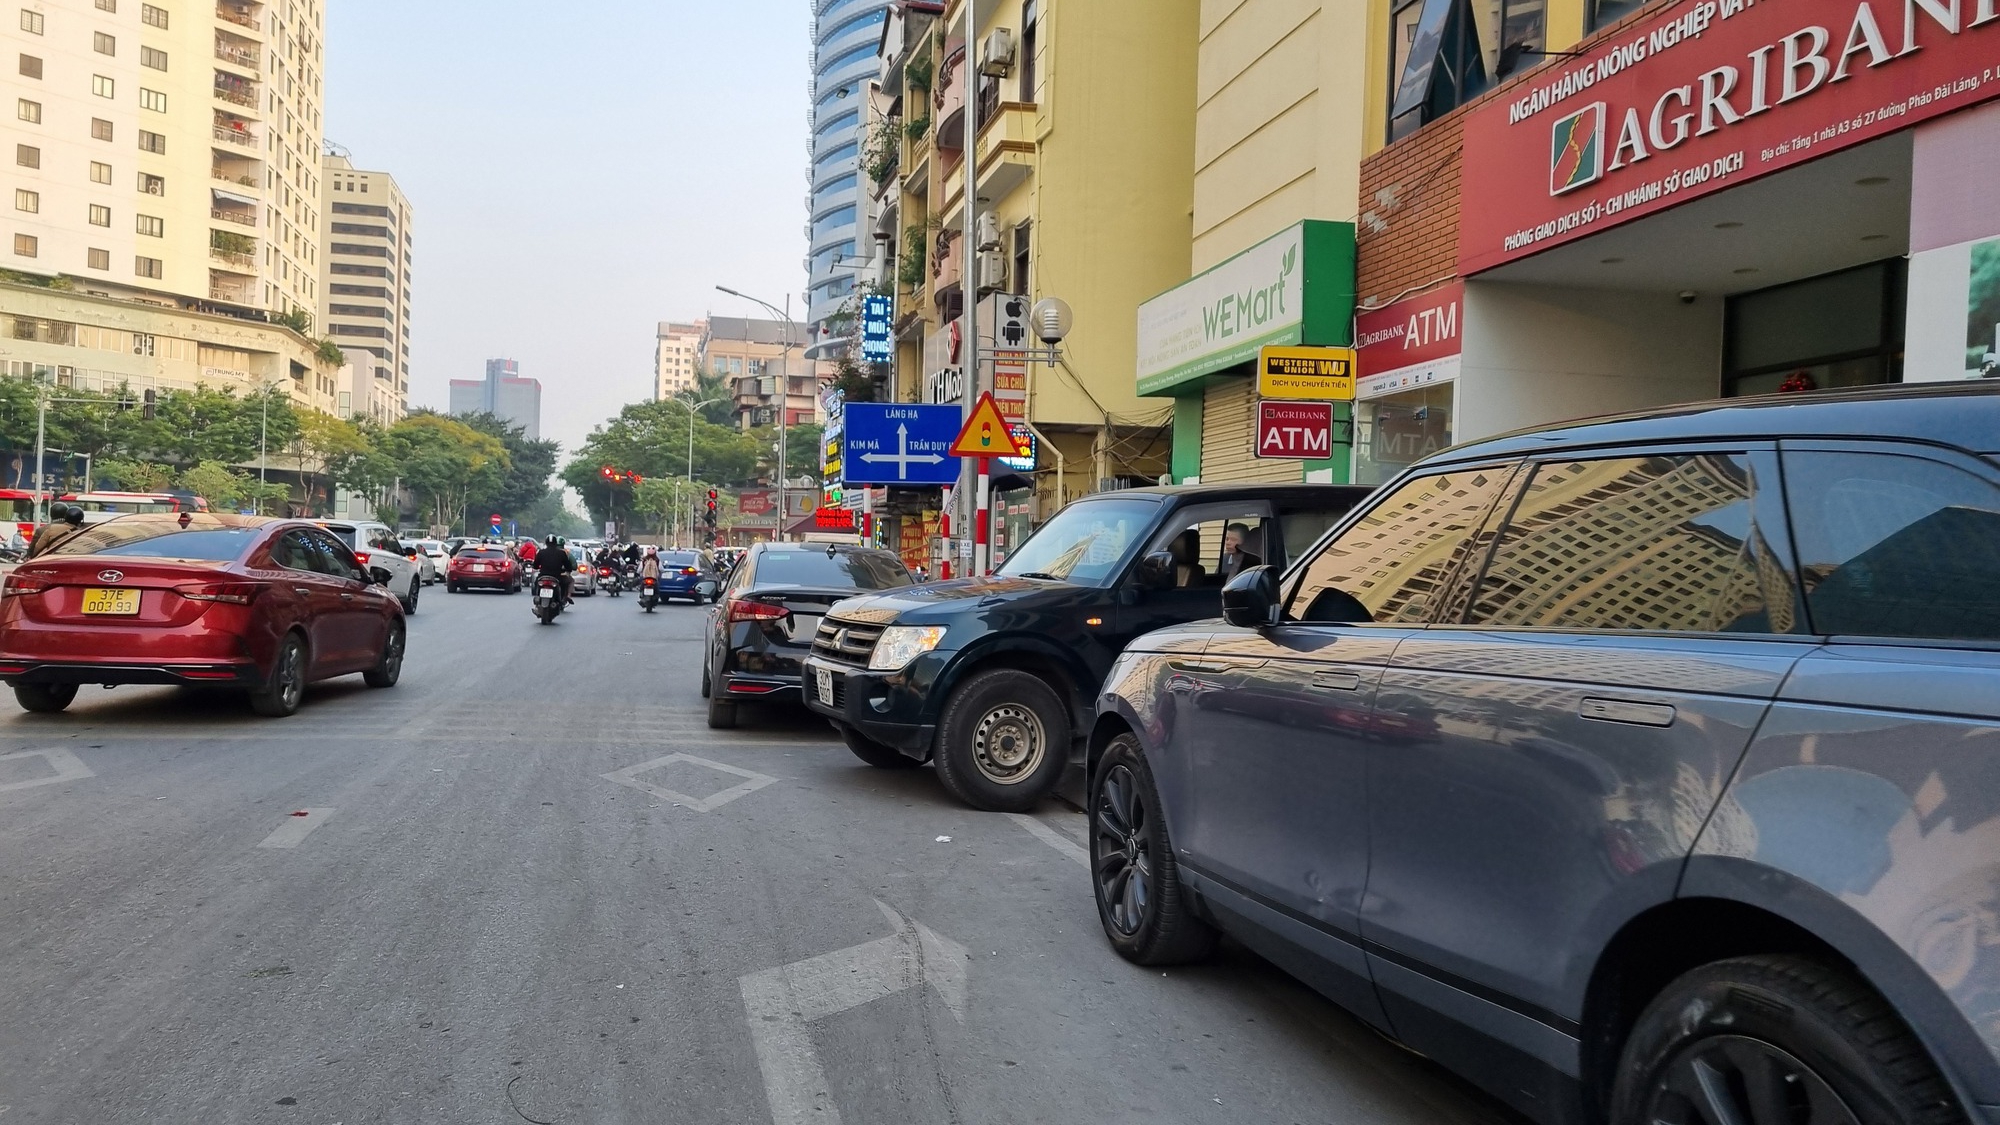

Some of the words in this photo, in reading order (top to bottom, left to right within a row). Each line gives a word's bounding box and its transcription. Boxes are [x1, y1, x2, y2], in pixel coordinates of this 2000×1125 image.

[1509, 85, 1550, 125] NGÂN
[1551, 62, 1596, 106] HÀNG
[1597, 36, 1647, 82] NÔNG
[1649, 2, 1717, 56] NGHIỆP
[1761, 149, 1774, 162] Địa
[1791, 135, 1811, 151] Tầng
[1813, 132, 1818, 143] 1
[1819, 125, 1836, 141] nhà
[1837, 122, 1850, 135] A3
[1851, 115, 1862, 130] số
[1864, 112, 1876, 125] 27
[1877, 102, 1907, 122] đường
[1908, 91, 1933, 110] Pháo
[1934, 83, 1951, 101] Đài
[1983, 69, 1994, 83] P.
[1504, 228, 1534, 251] PHÒNG
[1535, 219, 1556, 242] GIAO
[1557, 211, 1580, 234] DỊCH
[1581, 199, 1597, 225] SỐ
[1624, 181, 1662, 209] NHÁNH
[1664, 169, 1681, 196] SỞ
[1682, 164, 1709, 188] GIAO
[1713, 150, 1744, 179] DỊCH
[870, 302, 885, 316] TAI
[1202, 270, 1286, 343] WEMart
[868, 320, 886, 334] MŨI
[1366, 324, 1404, 347] AGRIBANK
[1403, 302, 1457, 350] ATM
[864, 340, 889, 355] HỌNG
[1270, 358, 1315, 367] WESTERN
[1284, 366, 1315, 374] UNION
[1272, 379, 1289, 387] DỊCH
[885, 406, 906, 419] LÁNG
[907, 409, 919, 421] HẠ
[1275, 411, 1327, 420] AGRIBANK
[850, 439, 866, 450] KIM
[867, 438, 879, 450] MÃ
[909, 438, 930, 450] TRẦN
[931, 441, 947, 451] DUY
[1262, 426, 1328, 451] ATM
[100, 589, 124, 600] 37E
[88, 601, 132, 612] 003.93
